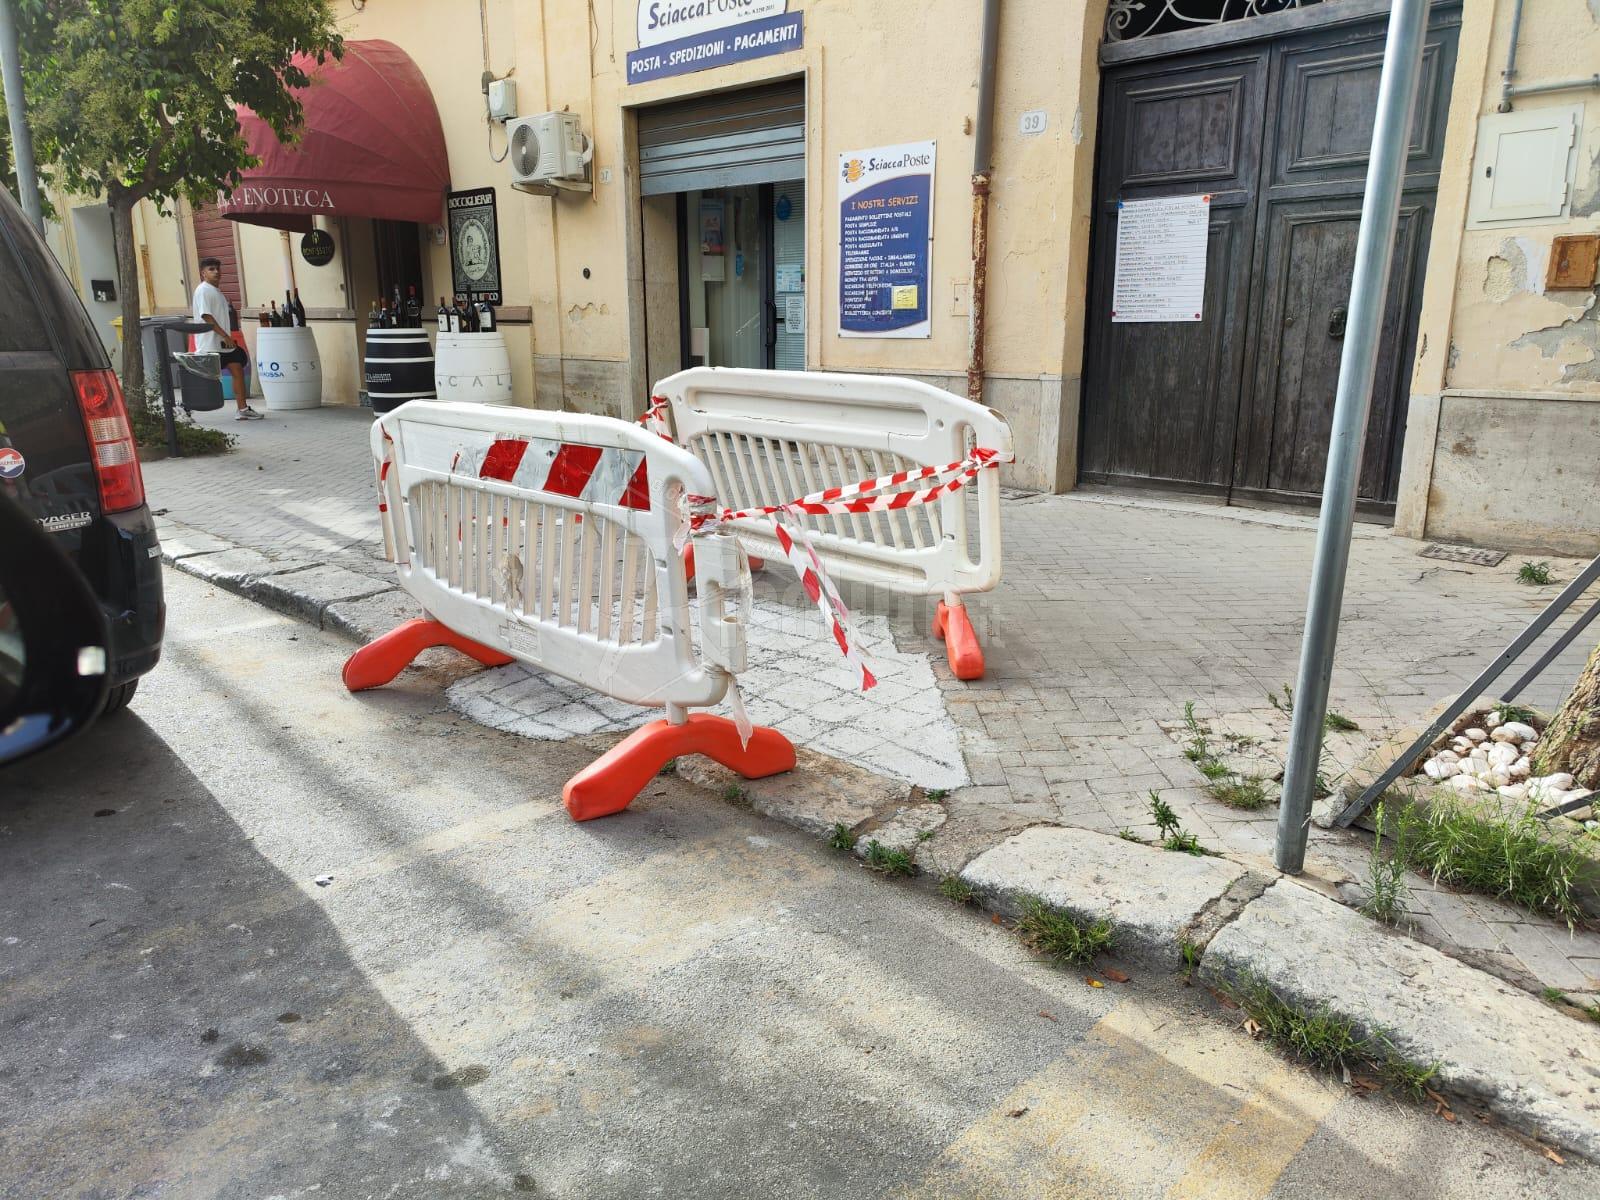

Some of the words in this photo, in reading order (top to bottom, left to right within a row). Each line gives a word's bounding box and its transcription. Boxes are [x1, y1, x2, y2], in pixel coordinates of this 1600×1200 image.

[631, 56, 661, 75] POSTA
[669, 41, 724, 66] SPEDIZIONI
[734, 23, 798, 51] PAGAMENTI
[1024, 115, 1040, 130] 39
[243, 187, 335, 208] ENOTECA
[857, 198, 885, 210] NOSTRI
[888, 195, 919, 208] SERVIZI
[37, 511, 91, 526] YAGER
